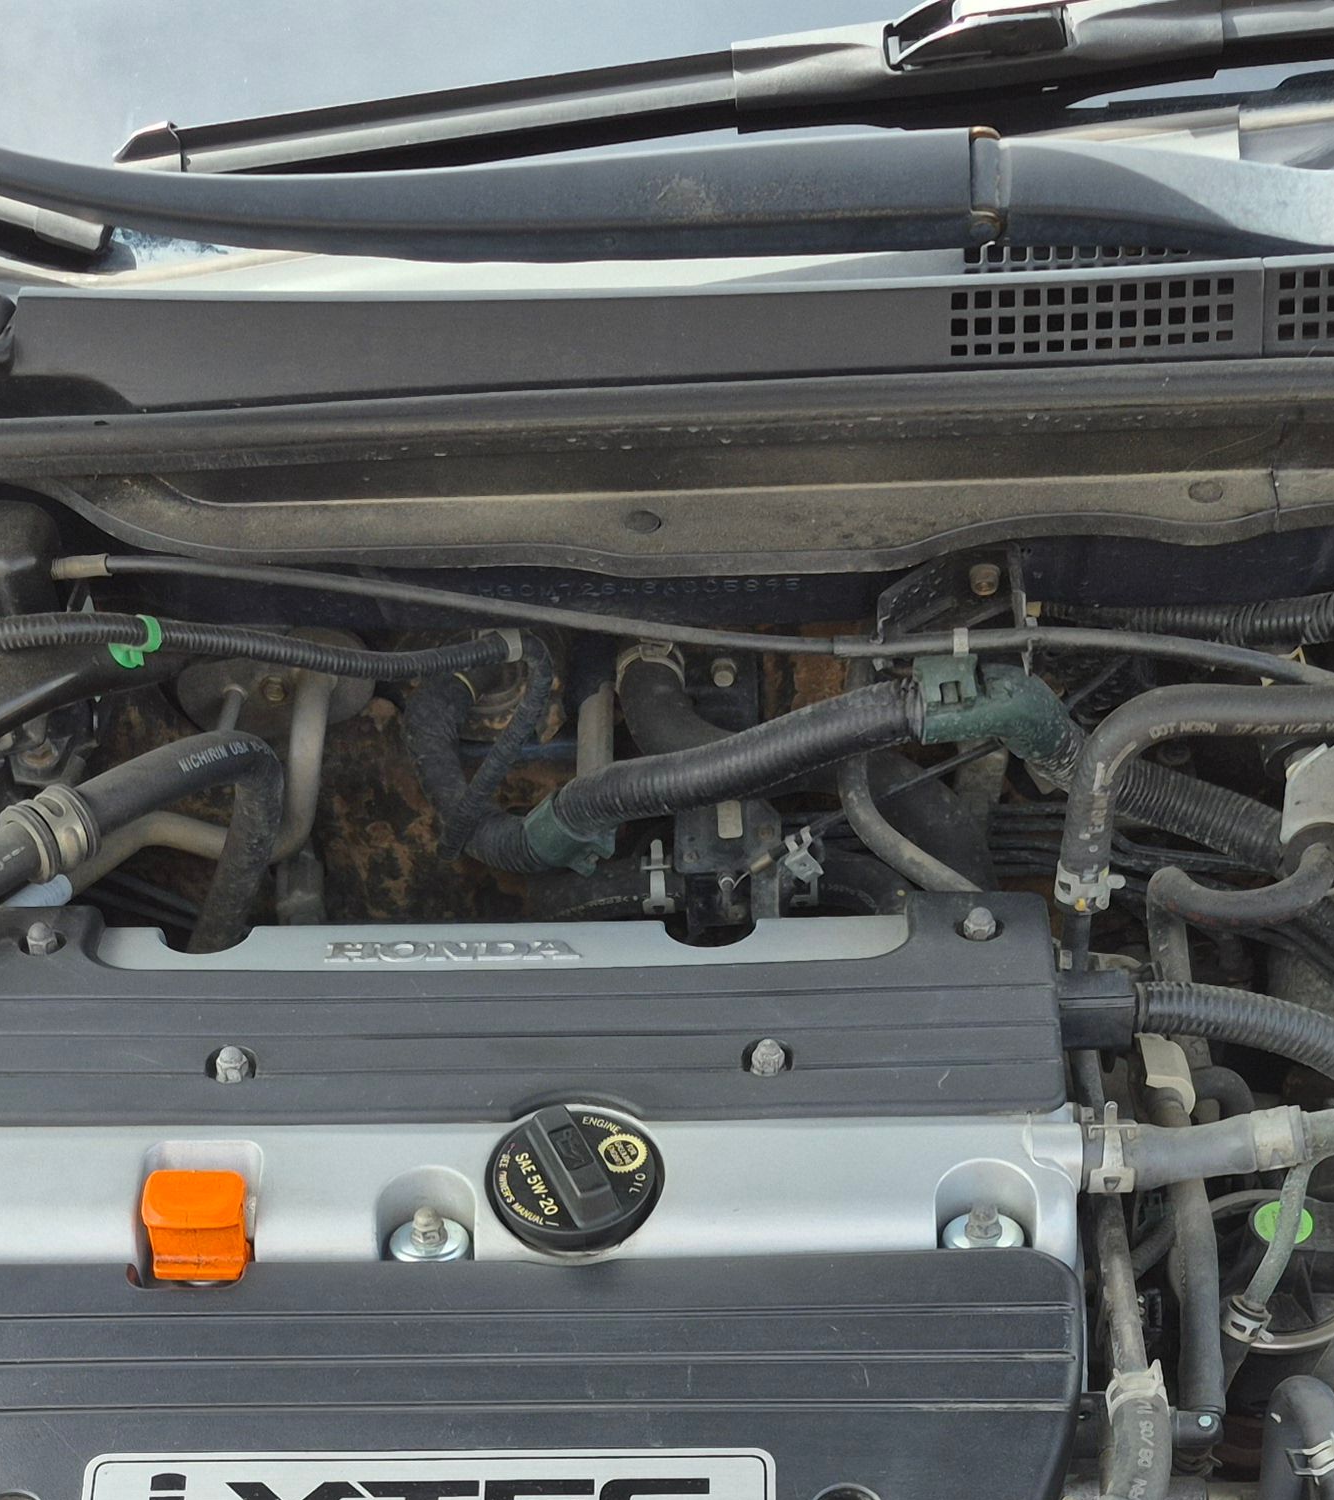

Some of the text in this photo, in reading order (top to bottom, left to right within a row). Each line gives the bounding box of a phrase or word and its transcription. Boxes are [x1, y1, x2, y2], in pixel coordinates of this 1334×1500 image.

[324, 940, 583, 963] HONDA
[515, 1152, 559, 1216] SAE 5W-20
[582, 1115, 647, 1194] ENGINE OIL
[499, 1153, 510, 1169] SEE
[511, 1201, 544, 1226] MANUAL
